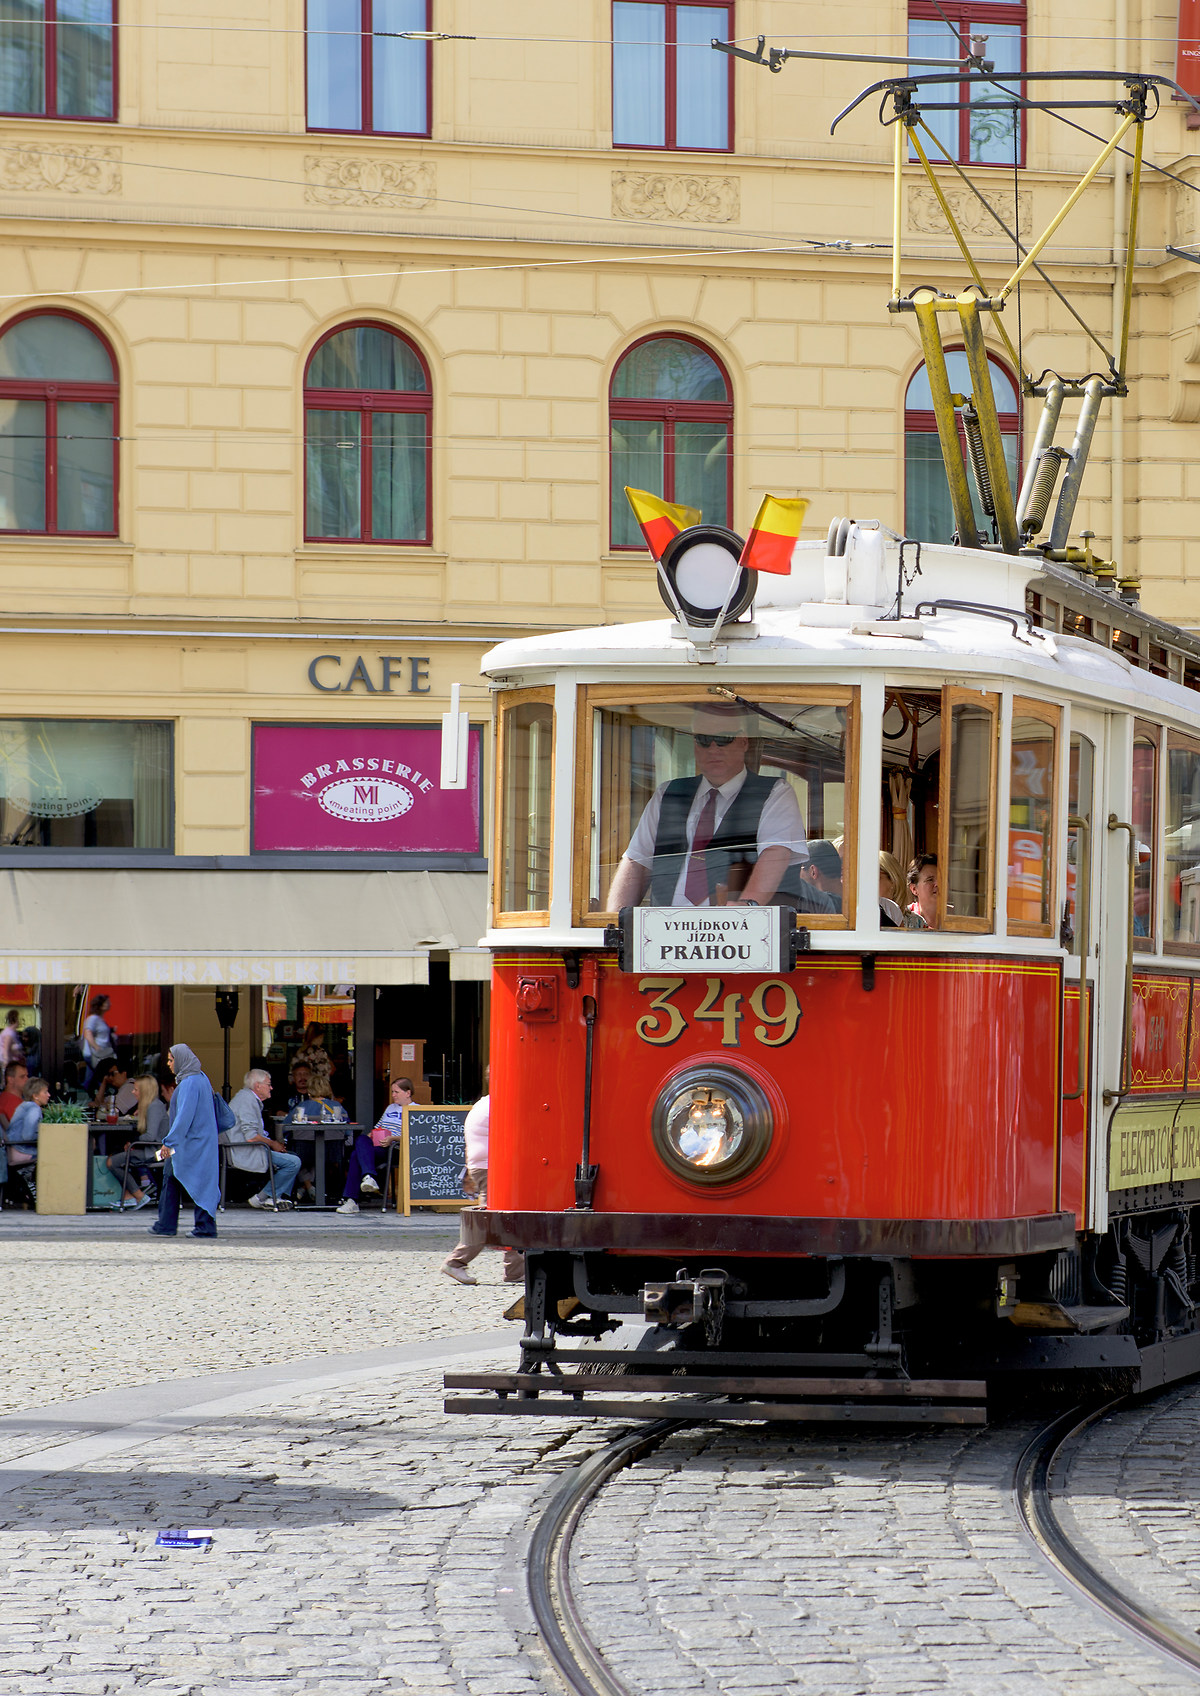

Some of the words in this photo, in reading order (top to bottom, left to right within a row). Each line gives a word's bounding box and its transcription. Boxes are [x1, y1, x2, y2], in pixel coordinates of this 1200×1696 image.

[308, 655, 431, 692] CAFE
[300, 757, 434, 794] BRASSERIE
[377, 800, 403, 815] point
[664, 919, 749, 931] VYHLÍDKOVÁ
[687, 931, 725, 942] JÍZDA
[660, 945, 751, 960] PRAHOU
[146, 960, 357, 982] BRASSERIE
[636, 977, 803, 1047] 349
[410, 1135, 442, 1146] MENU
[1120, 1115, 1180, 1177] ELEKTRICKÉ
[412, 1165, 455, 1175] EVERYDAY
